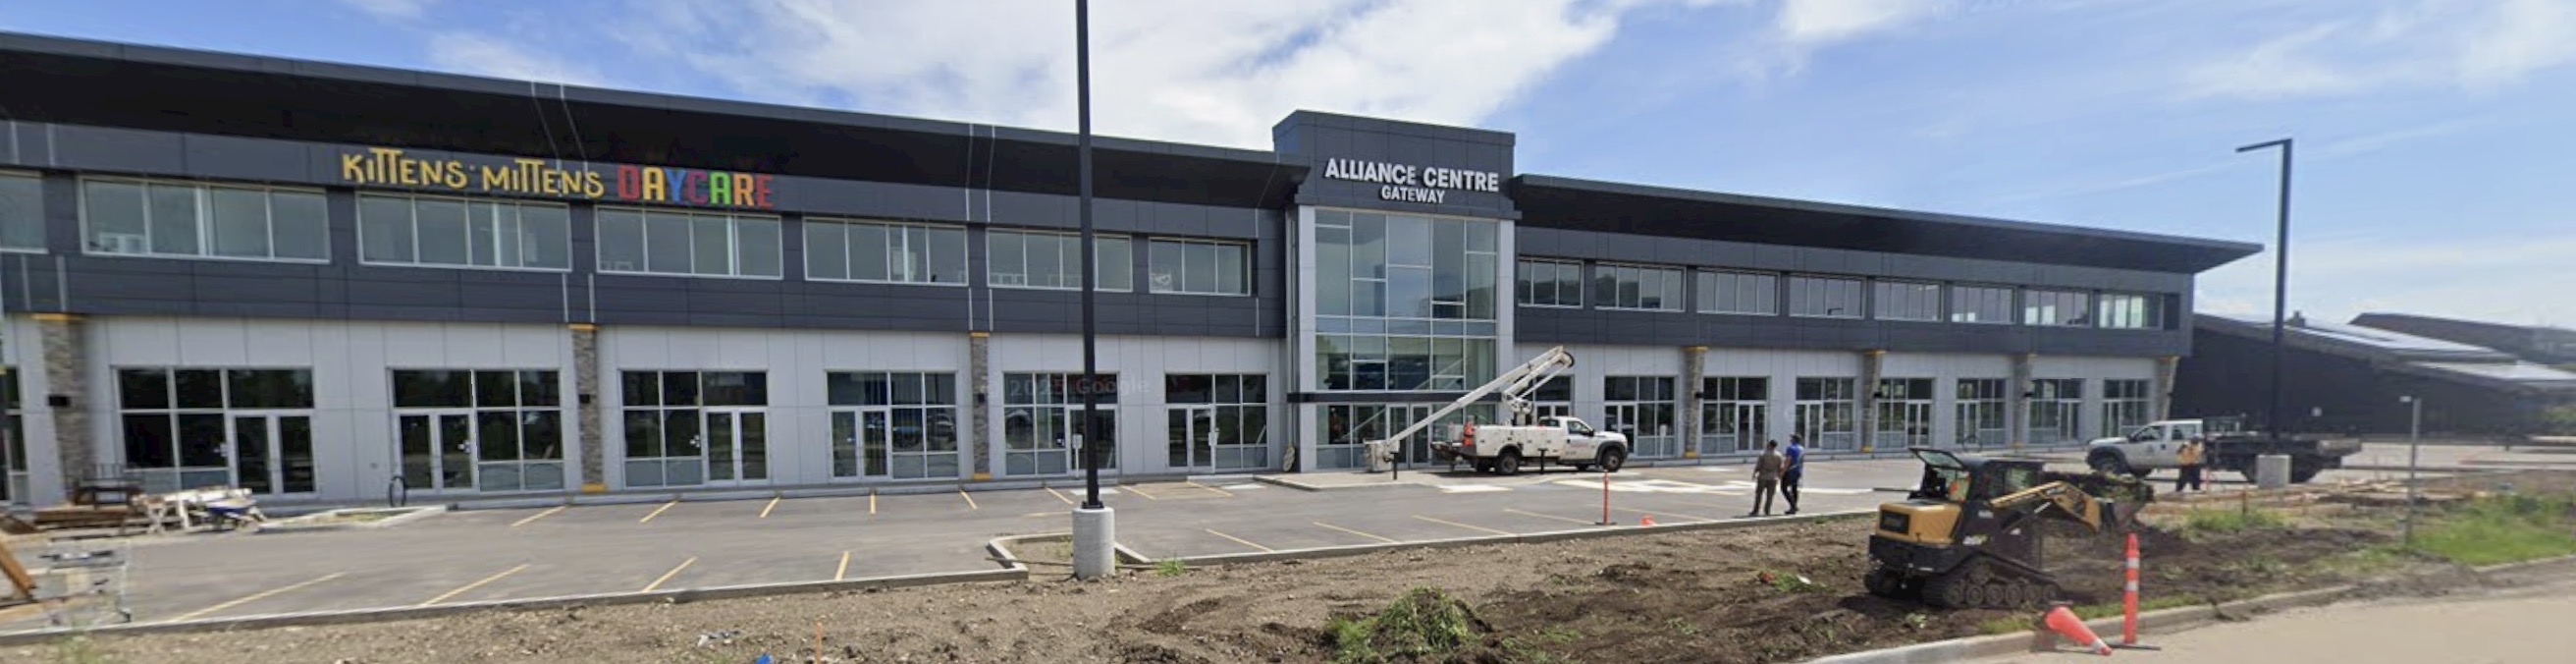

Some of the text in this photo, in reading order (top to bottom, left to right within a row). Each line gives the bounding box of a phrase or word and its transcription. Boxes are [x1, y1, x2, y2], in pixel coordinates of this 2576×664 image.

[481, 157, 605, 198] MITTENS
[617, 163, 775, 208] DAYCARE
[1324, 157, 1500, 193] ALLIANCE CENTRE
[1381, 184, 1446, 204] GATEWAY
